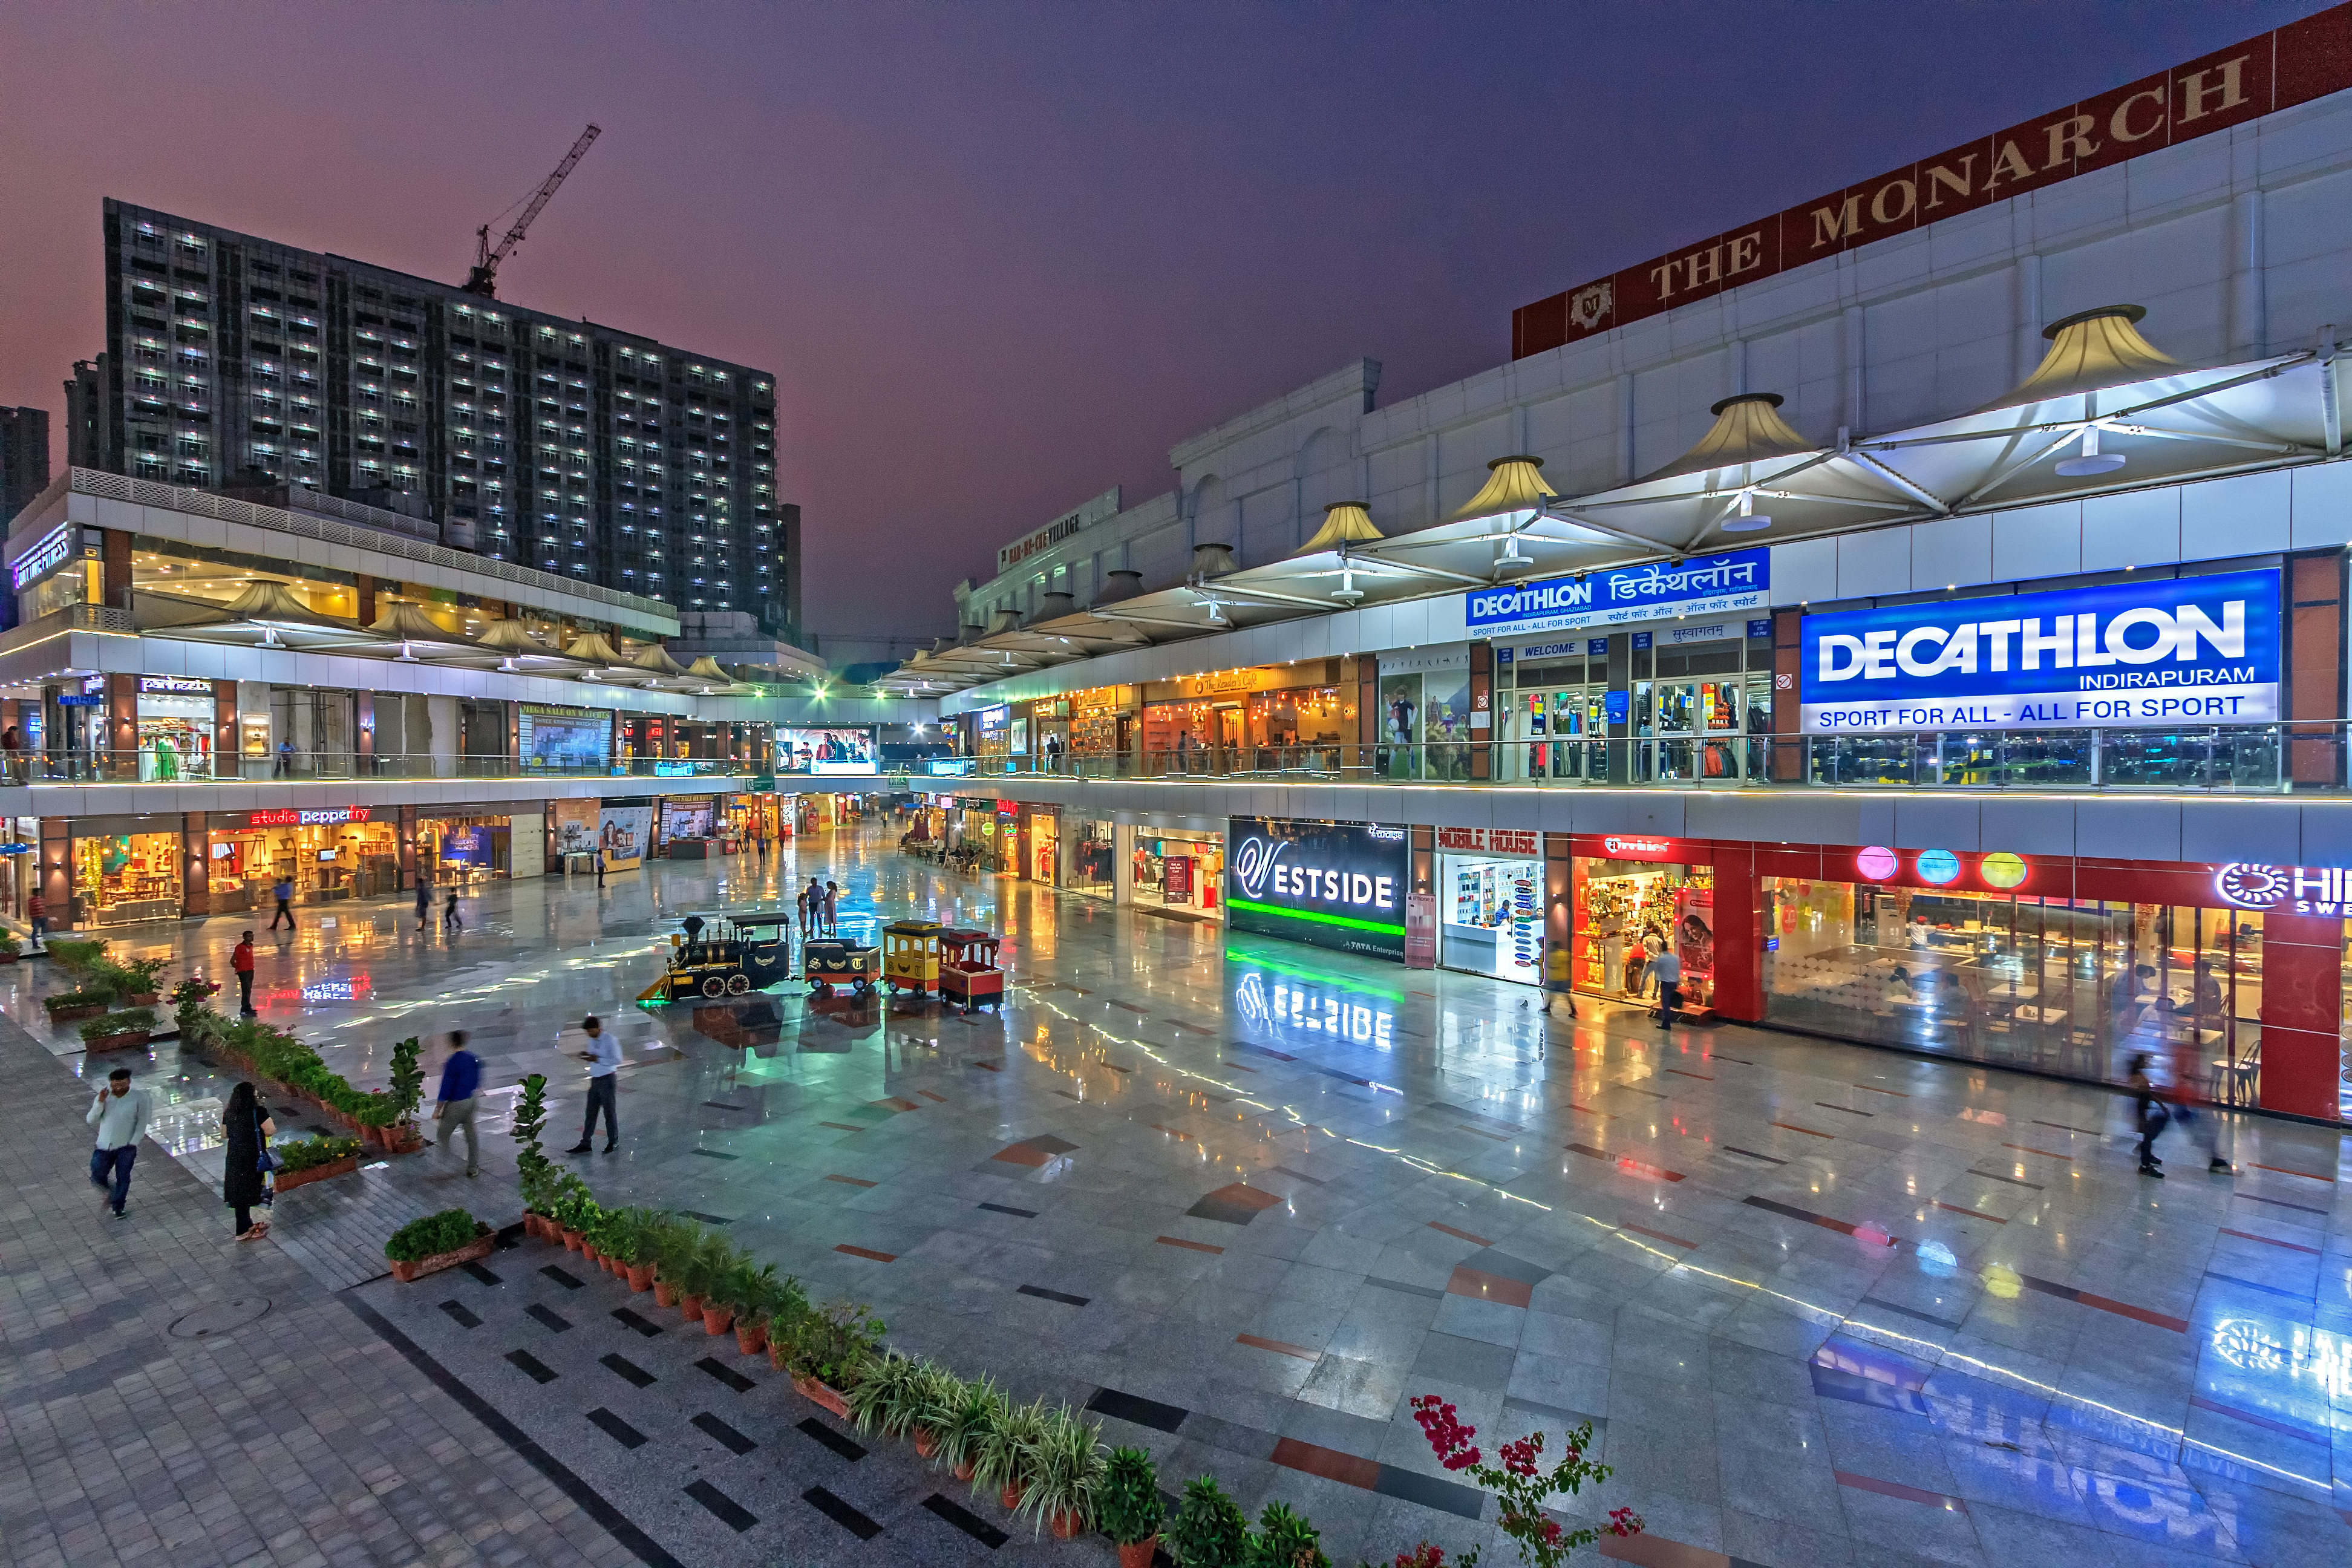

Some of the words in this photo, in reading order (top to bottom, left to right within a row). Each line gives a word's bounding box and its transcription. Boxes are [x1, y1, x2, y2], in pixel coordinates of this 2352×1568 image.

[1650, 230, 1761, 301] THE
[1810, 54, 2251, 249] MONARCH
[1584, 297, 1598, 314] M
[1048, 514, 1079, 545] VILLAGE
[1608, 558, 1757, 601] डिकैथलॉन
[1473, 583, 1592, 618] DECATHLON
[1560, 605, 1592, 614] GHAZIABAD
[1473, 627, 1495, 636] SPORT
[1547, 619, 1563, 628] FOR
[1565, 616, 1592, 625] SPORT
[1672, 625, 1724, 642] सुस्वागतम्
[1525, 642, 1575, 656] WELCOME
[1818, 599, 2245, 682] DECATHLON
[1205, 678, 1215, 690] The
[1217, 676, 1241, 688] Reader's
[1243, 673, 1257, 689] Café
[2080, 667, 2255, 690] INDIRAPURAM
[521, 705, 544, 715] MEGA
[546, 707, 565, 716] SALE
[1820, 710, 1891, 727] SPORT
[1899, 708, 1944, 725] FOR
[1952, 706, 1996, 724] ALL
[2019, 703, 2067, 721] ALL
[2076, 701, 2131, 719] FOR
[2141, 696, 2245, 717] SPORT
[251, 809, 298, 825] studio
[301, 805, 370, 825] pepperfry
[1438, 826, 1485, 851] MOBILE
[1489, 829, 1537, 854] HOUSE
[1236, 837, 1393, 908] WESTSIDE
[2296, 900, 2352, 915] SWE
[1350, 941, 1371, 950] TATA
[1373, 945, 1404, 956] Enterprise
